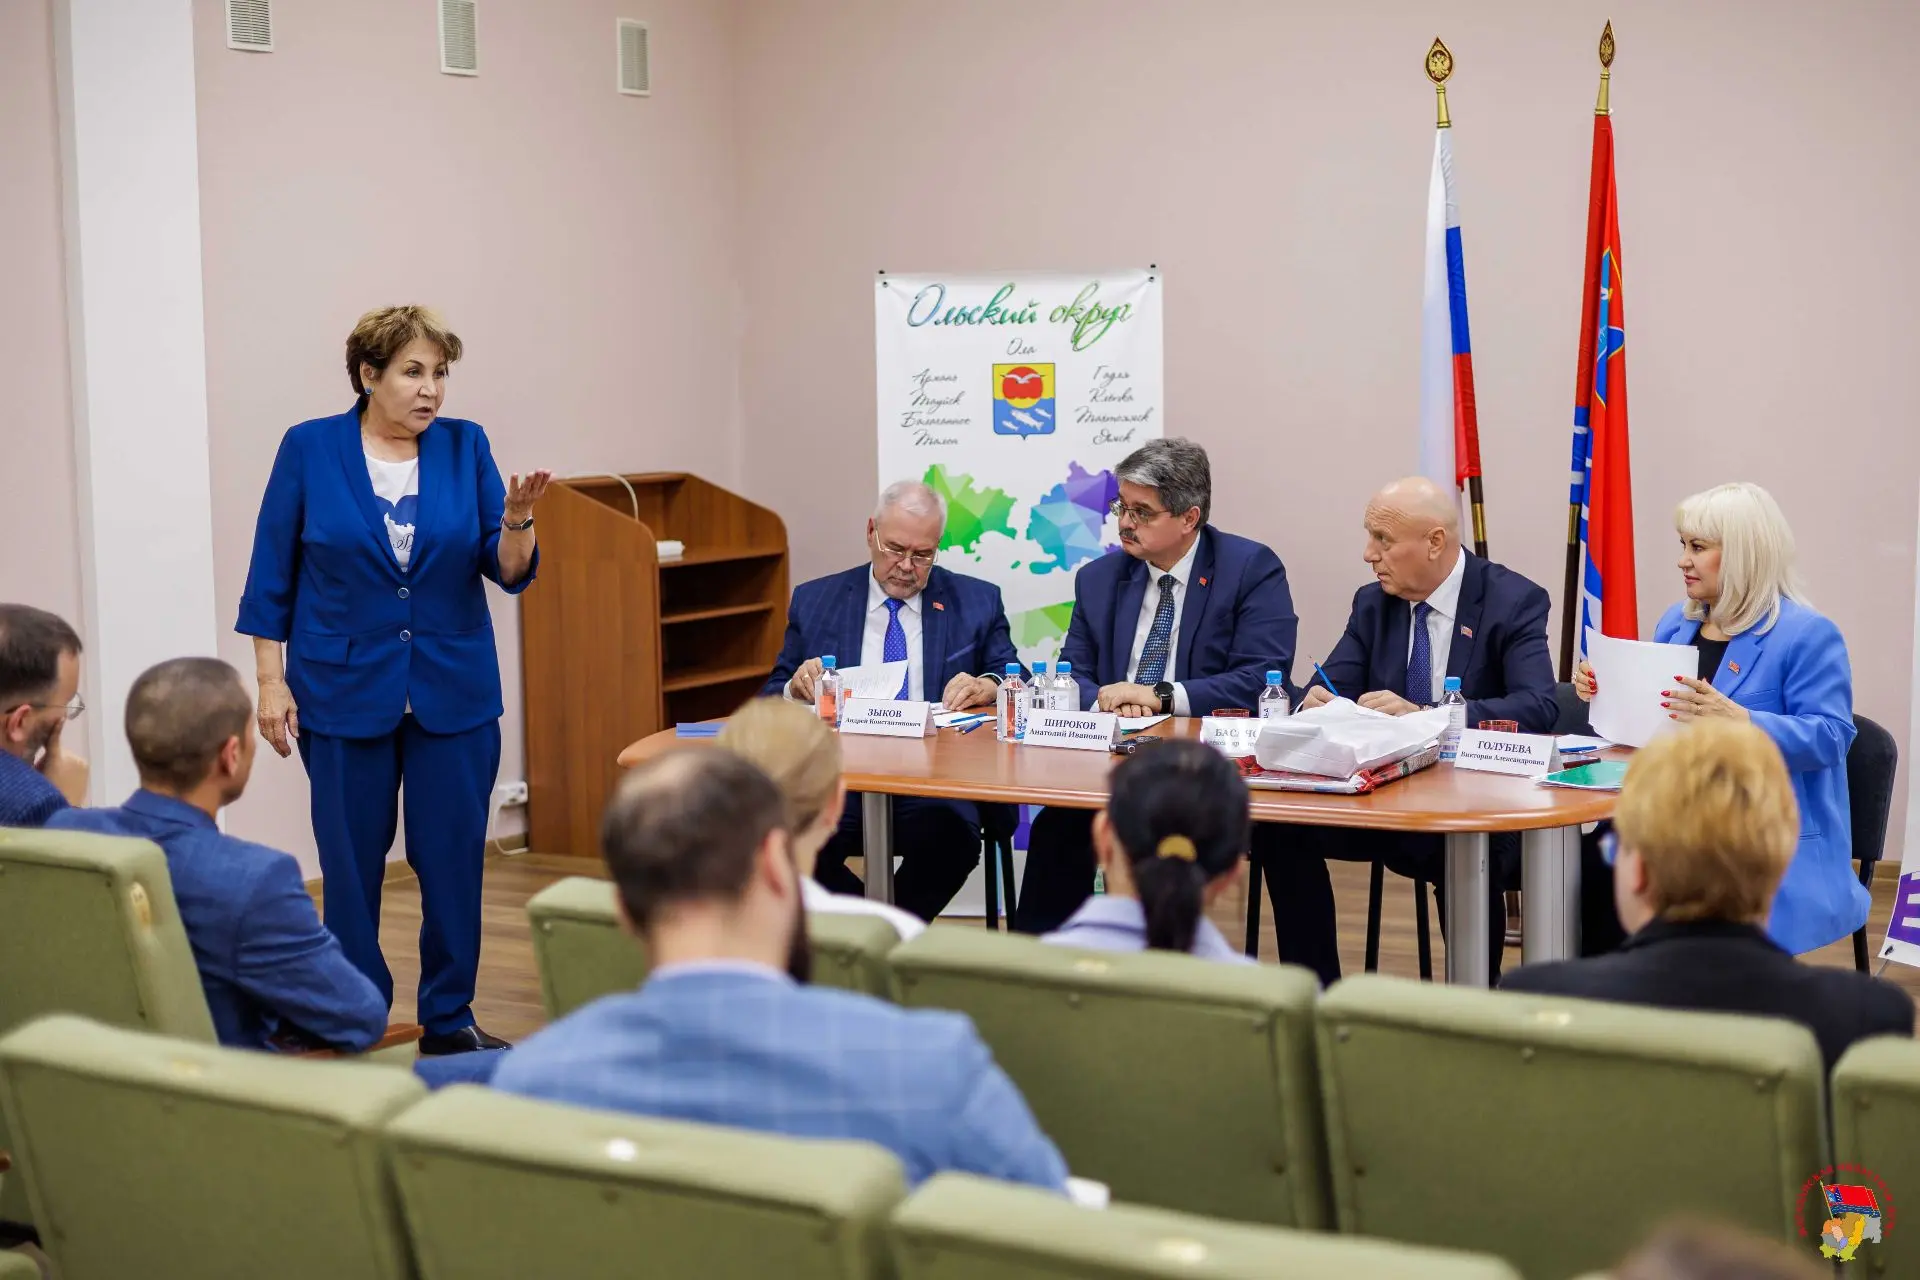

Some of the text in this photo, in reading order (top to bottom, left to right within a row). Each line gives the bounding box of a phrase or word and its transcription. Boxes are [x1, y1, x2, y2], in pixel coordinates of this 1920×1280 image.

[907, 281, 1134, 351] Ольский округ
[1006, 337, 1037, 355] Ола
[867, 708, 902, 718] ЗЫКОВ
[869, 718, 921, 727] Константинович
[1044, 718, 1097, 730] ШИРОКОВ
[1029, 728, 1107, 740] Анатолий Иванович
[1477, 740, 1532, 754] ГОЛУБЕВА
[1460, 751, 1545, 766] Виктория Александровна
